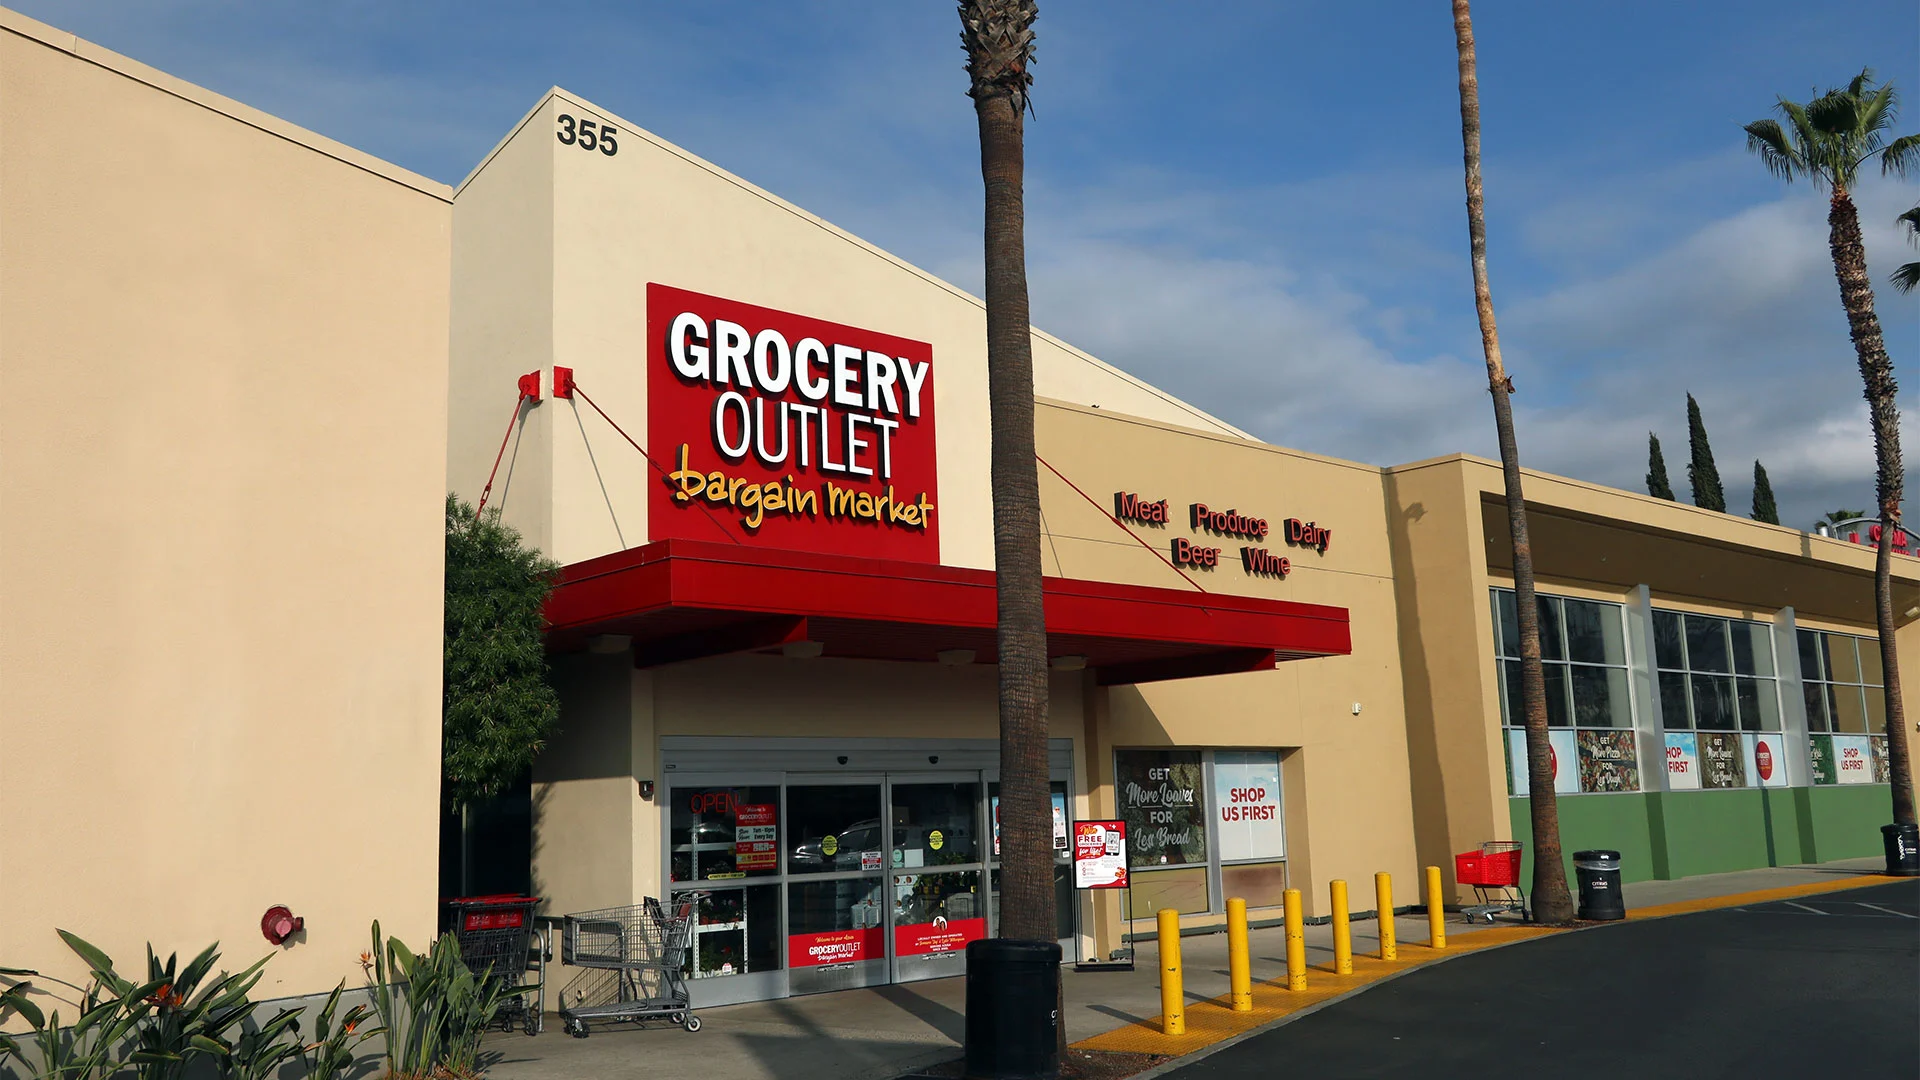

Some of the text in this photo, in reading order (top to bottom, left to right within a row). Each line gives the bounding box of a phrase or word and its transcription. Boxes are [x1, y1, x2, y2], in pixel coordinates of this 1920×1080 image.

[556, 114, 619, 157] 355
[667, 311, 929, 418] GROCERY
[712, 391, 899, 480] OUTLET
[668, 443, 935, 529] bargain market
[1116, 491, 1332, 552] Meat Produce Dairy
[1173, 537, 1291, 575] Beer Wine
[1665, 747, 1681, 758] HOP
[1844, 748, 1858, 757] SHOP
[1668, 761, 1688, 773] FIRST
[1841, 760, 1863, 770] US FIRST
[1149, 768, 1170, 781] GET
[691, 793, 739, 814] OPEN
[1126, 782, 1194, 807] More Loaves
[1231, 788, 1265, 803] SHOP
[1150, 811, 1173, 824] FOR
[1222, 805, 1276, 821] US FIRST
[1134, 827, 1191, 851] Less Bread
[817, 953, 837, 963] bargain
